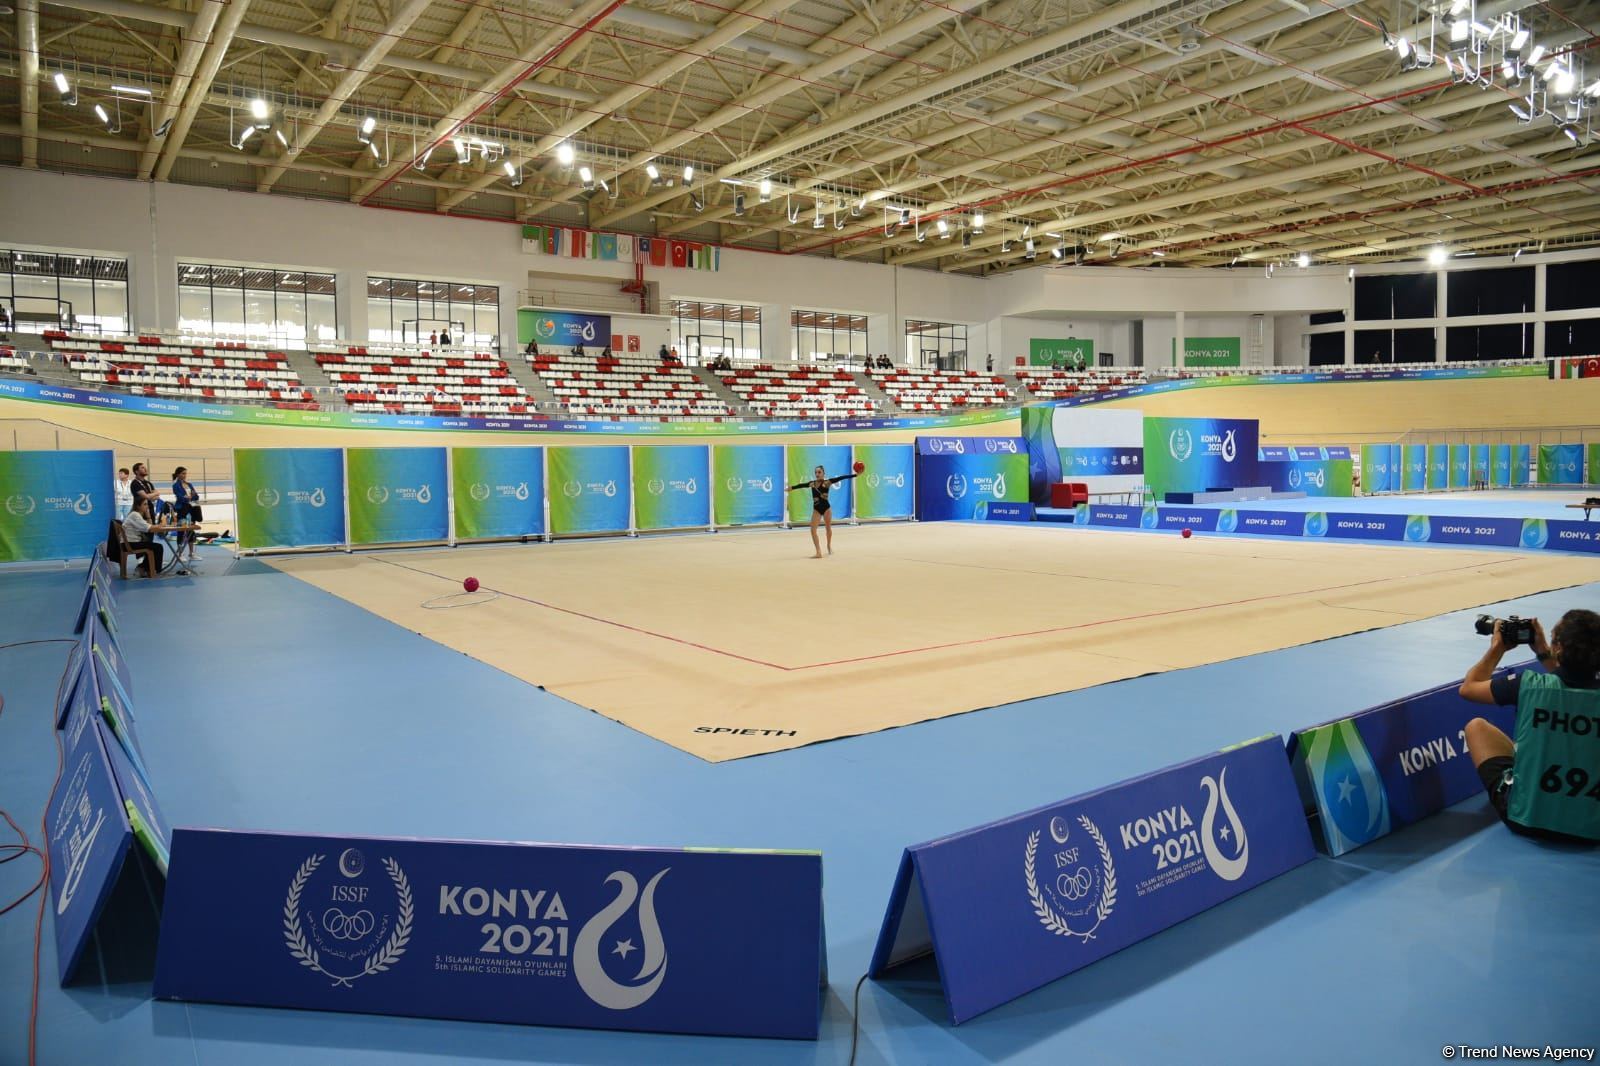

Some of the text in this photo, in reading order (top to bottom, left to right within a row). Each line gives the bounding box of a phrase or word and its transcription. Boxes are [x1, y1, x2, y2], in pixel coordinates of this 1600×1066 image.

[1213, 350, 1230, 358] 2021
[11, 385, 25, 393] 2021
[40, 390, 62, 398] KONYA
[88, 395, 109, 403] KONYA
[1201, 435, 1222, 443] KONYA
[1208, 443, 1222, 451] 2021
[1337, 521, 1386, 530] KONYA 2021
[1441, 526, 1496, 535] KONYA 2021
[1559, 530, 1591, 540] KONYA
[693, 726, 797, 737] SPIETH
[1399, 736, 1457, 776] KONYA
[1119, 805, 1193, 850] KONYA
[1152, 830, 1201, 870] 2021
[1053, 847, 1079, 869] ISSF
[1165, 870, 1191, 886] SOLIDARITY
[331, 885, 369, 903] ISSF
[439, 885, 568, 920] KONYA
[480, 923, 568, 957] 2021
[435, 955, 442, 963] 5.
[524, 960, 567, 970] OYUNLARI
[486, 966, 535, 976] SOLIDARITY
[538, 969, 567, 978] GAMES
